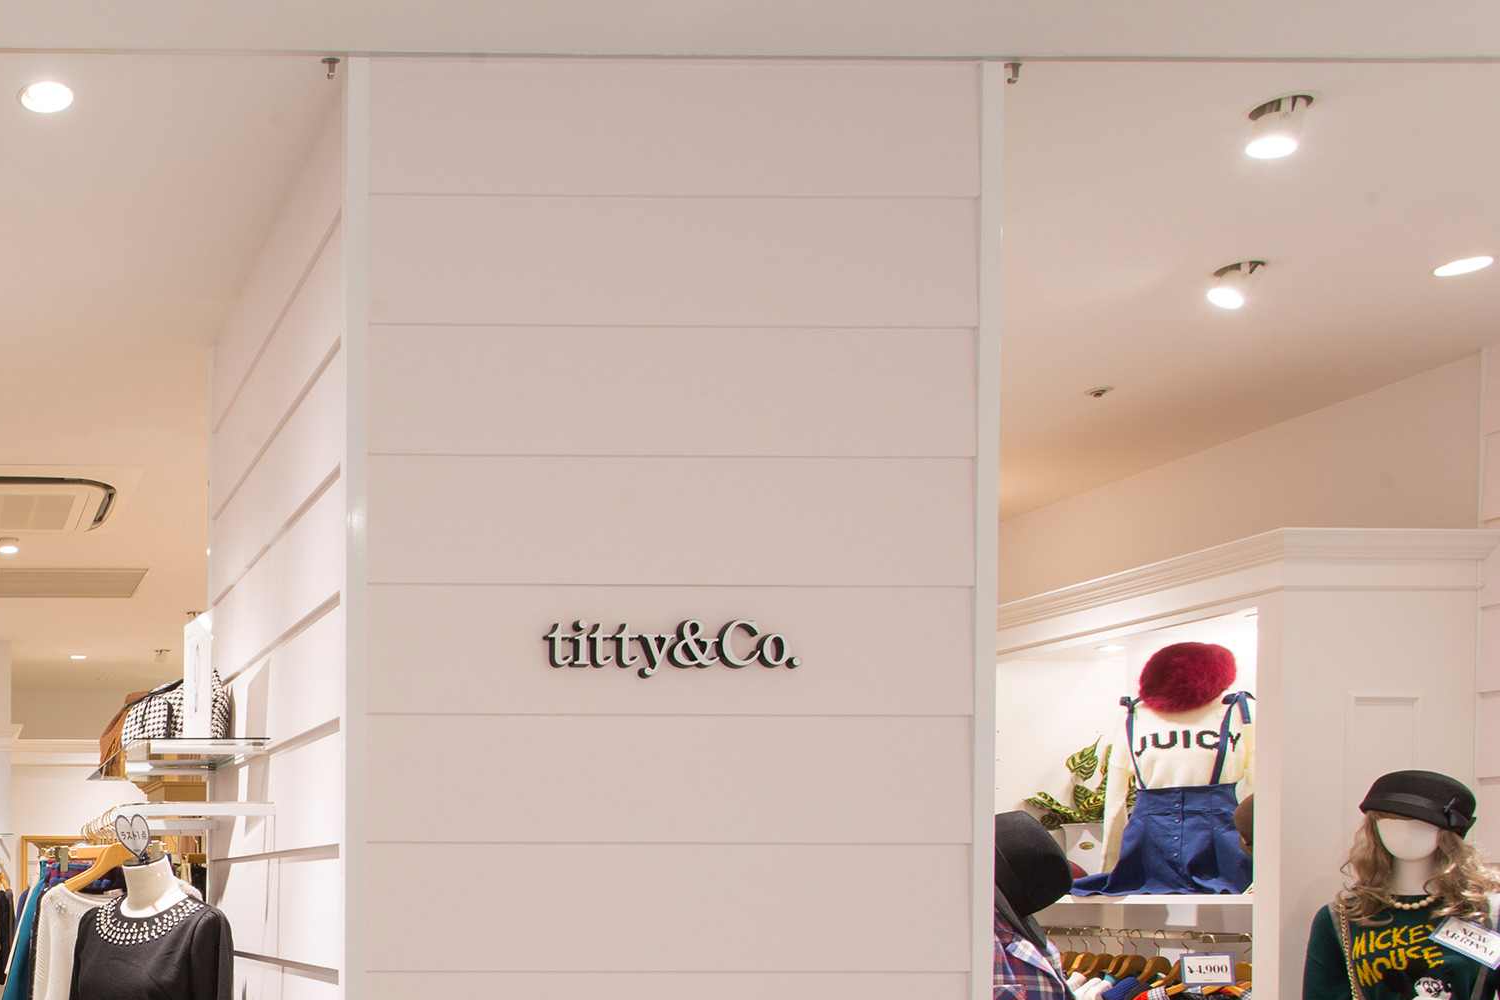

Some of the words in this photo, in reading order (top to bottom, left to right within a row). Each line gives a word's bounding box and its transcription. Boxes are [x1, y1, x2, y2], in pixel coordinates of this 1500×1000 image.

[542, 619, 802, 679] titty&Co.
[1134, 730, 1242, 758] JUICY
[1461, 927, 1488, 944] NEW
